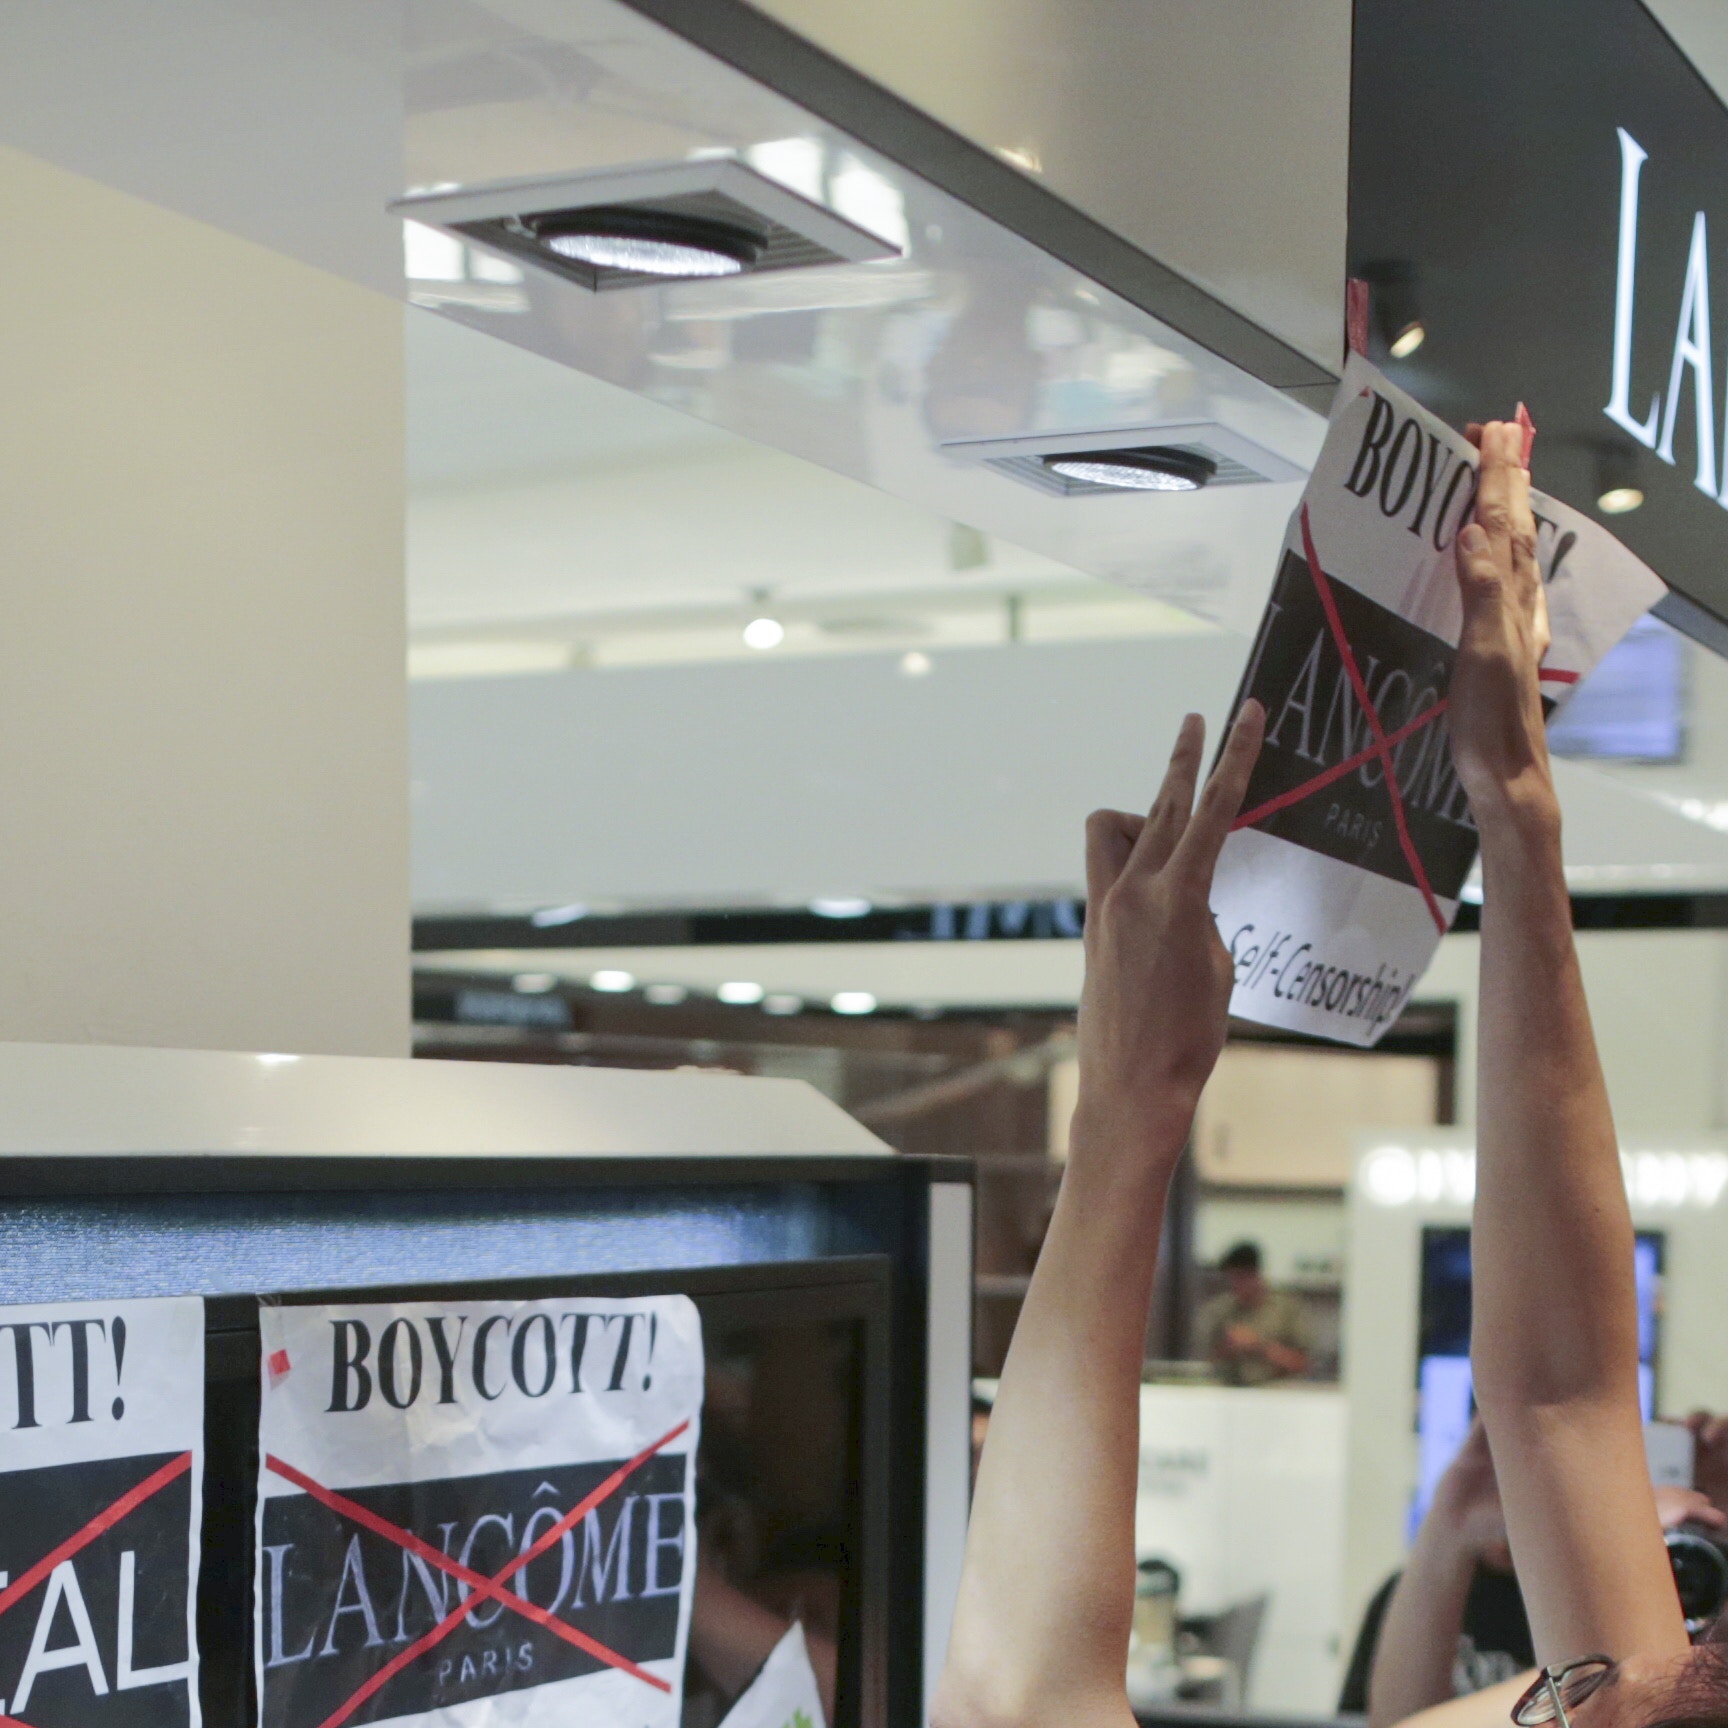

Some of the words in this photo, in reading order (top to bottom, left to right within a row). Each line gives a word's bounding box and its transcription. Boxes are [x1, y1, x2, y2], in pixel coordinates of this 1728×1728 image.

[1325, 802, 1383, 848] PARIS
[323, 1310, 658, 1413] BOYCOTT!
[263, 1481, 689, 1670] LANCÔME
[438, 1643, 535, 1686] PARIS
